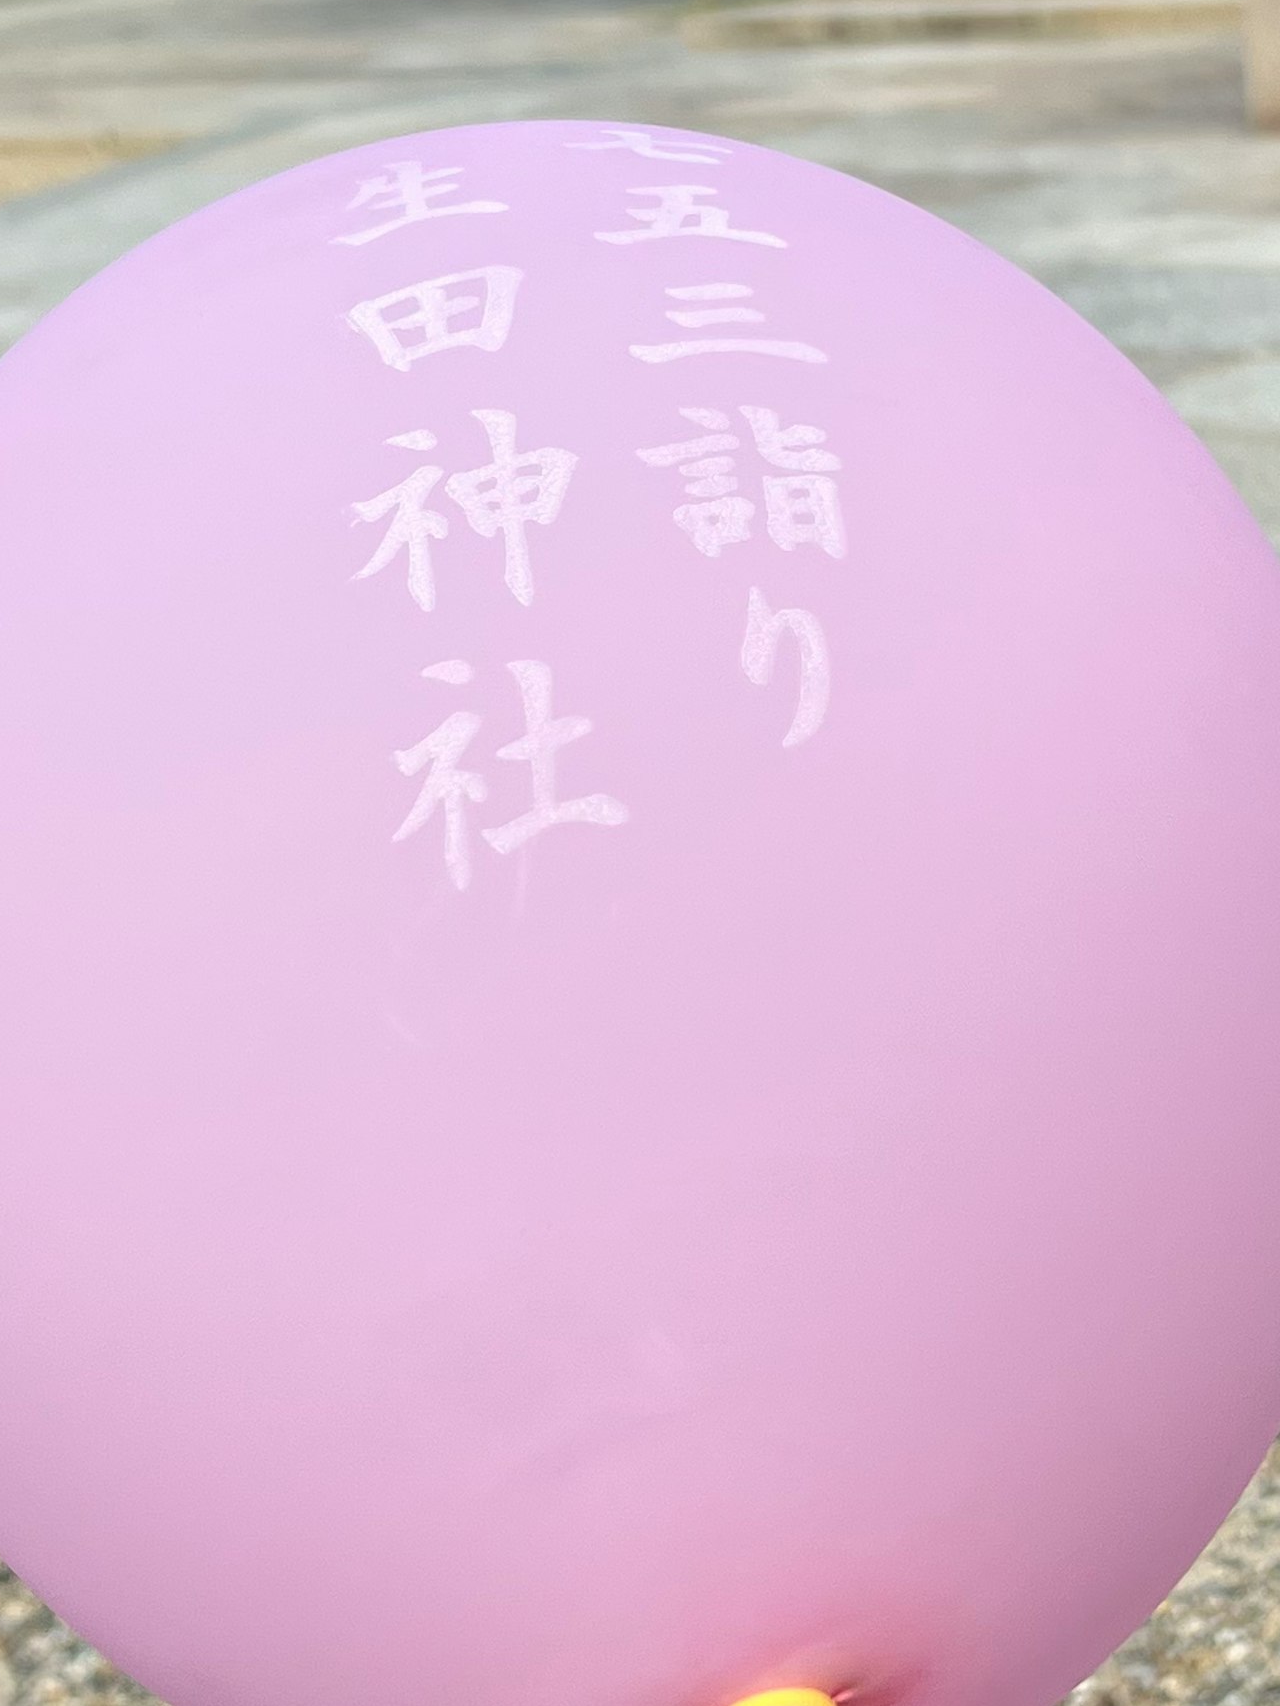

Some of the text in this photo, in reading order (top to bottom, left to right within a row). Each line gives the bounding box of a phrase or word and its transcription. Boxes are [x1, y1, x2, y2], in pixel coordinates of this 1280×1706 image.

[329, 161, 629, 891] 生田神社
[563, 131, 847, 748] 七五三詣り
